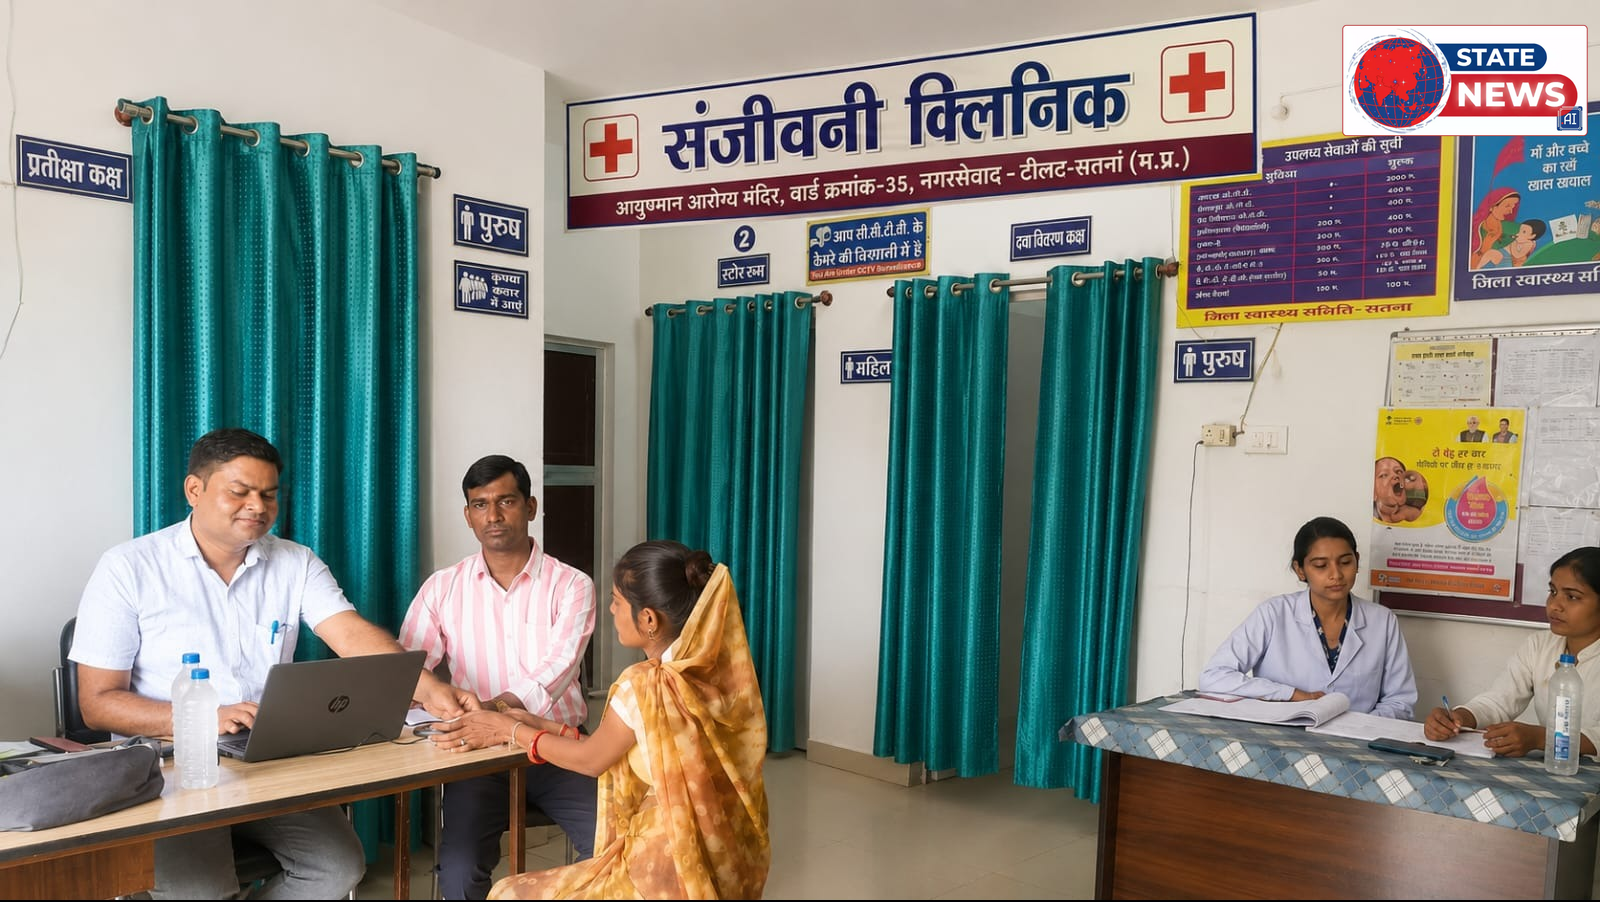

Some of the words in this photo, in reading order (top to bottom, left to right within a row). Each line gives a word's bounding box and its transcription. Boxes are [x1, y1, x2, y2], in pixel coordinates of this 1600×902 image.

[662, 81, 884, 170] संजीवनी
[904, 61, 1131, 146] क्लिनिक
[1362, 137, 1376, 152] की
[26, 148, 84, 184] प्रतीक्षा
[88, 163, 123, 190] कक्ष
[688, 188, 738, 210] आरोग्य
[743, 183, 784, 206] मंदिर,
[789, 178, 820, 202] वार्ड
[919, 163, 1002, 189] नगरसेवाद
[1129, 145, 1190, 176] (म.प्र.)
[1542, 162, 1558, 174] का
[479, 212, 522, 243] पुरुष
[833, 229, 854, 242] आप
[912, 217, 924, 234] के
[1066, 228, 1086, 246] कक्ष
[740, 230, 750, 248] 2
[838, 248, 852, 264] की
[900, 240, 911, 258] में
[722, 262, 745, 280] स्टोर
[857, 266, 876, 274] CCTV
[1472, 273, 1512, 290] जिला
[1516, 271, 1574, 287] स्वास्थ्य
[1204, 310, 1240, 321] जिला
[856, 356, 892, 378] महिल
[1202, 350, 1246, 376] पुरुष
